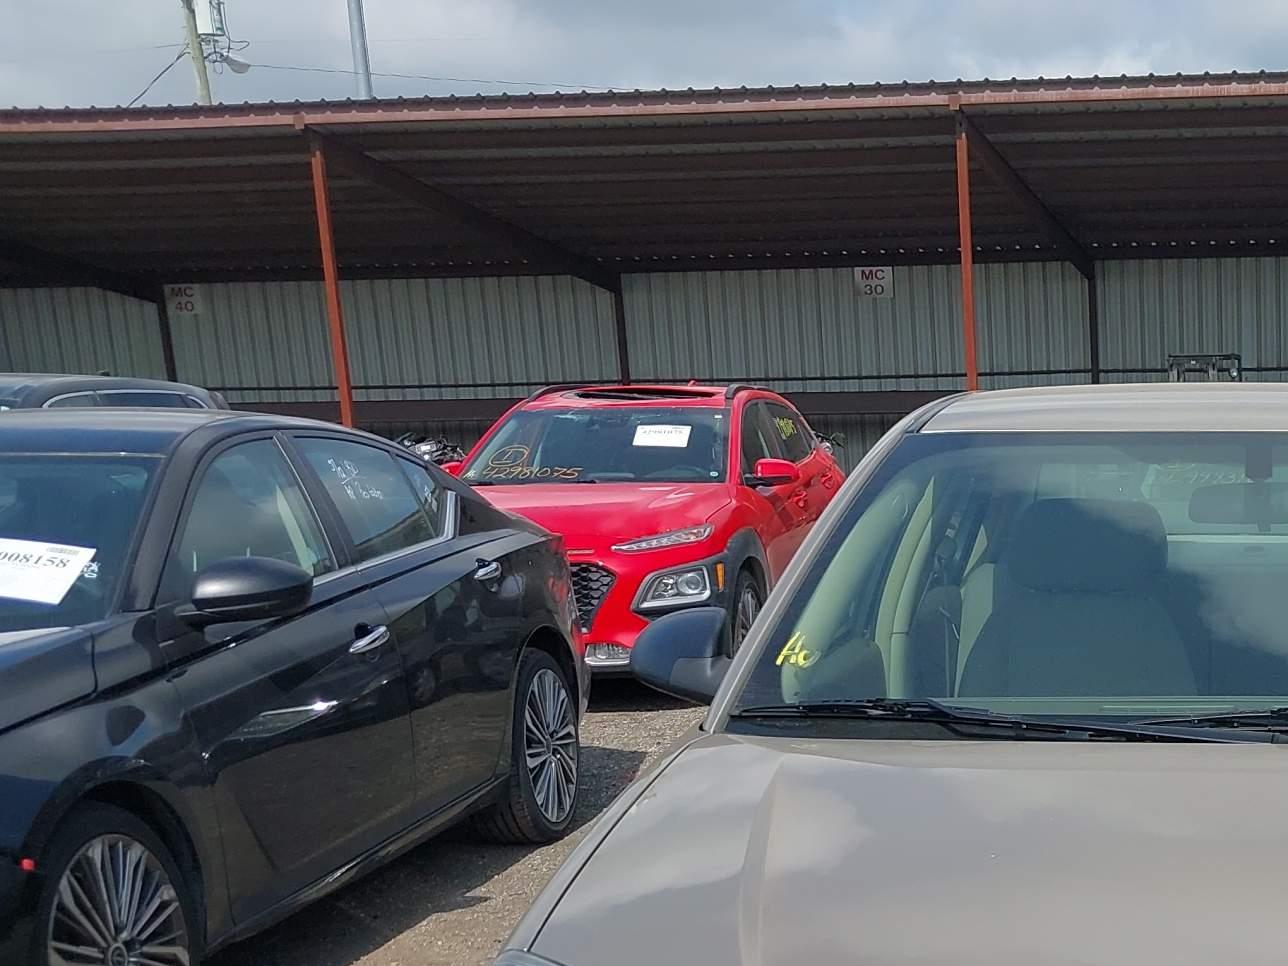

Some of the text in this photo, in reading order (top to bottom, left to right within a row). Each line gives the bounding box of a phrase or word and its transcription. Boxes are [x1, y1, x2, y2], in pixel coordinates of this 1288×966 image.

[861, 269, 885, 280] MC
[170, 287, 195, 297] MC
[863, 284, 885, 295] 30
[175, 301, 193, 312] 40
[482, 466, 583, 479] 42981075
